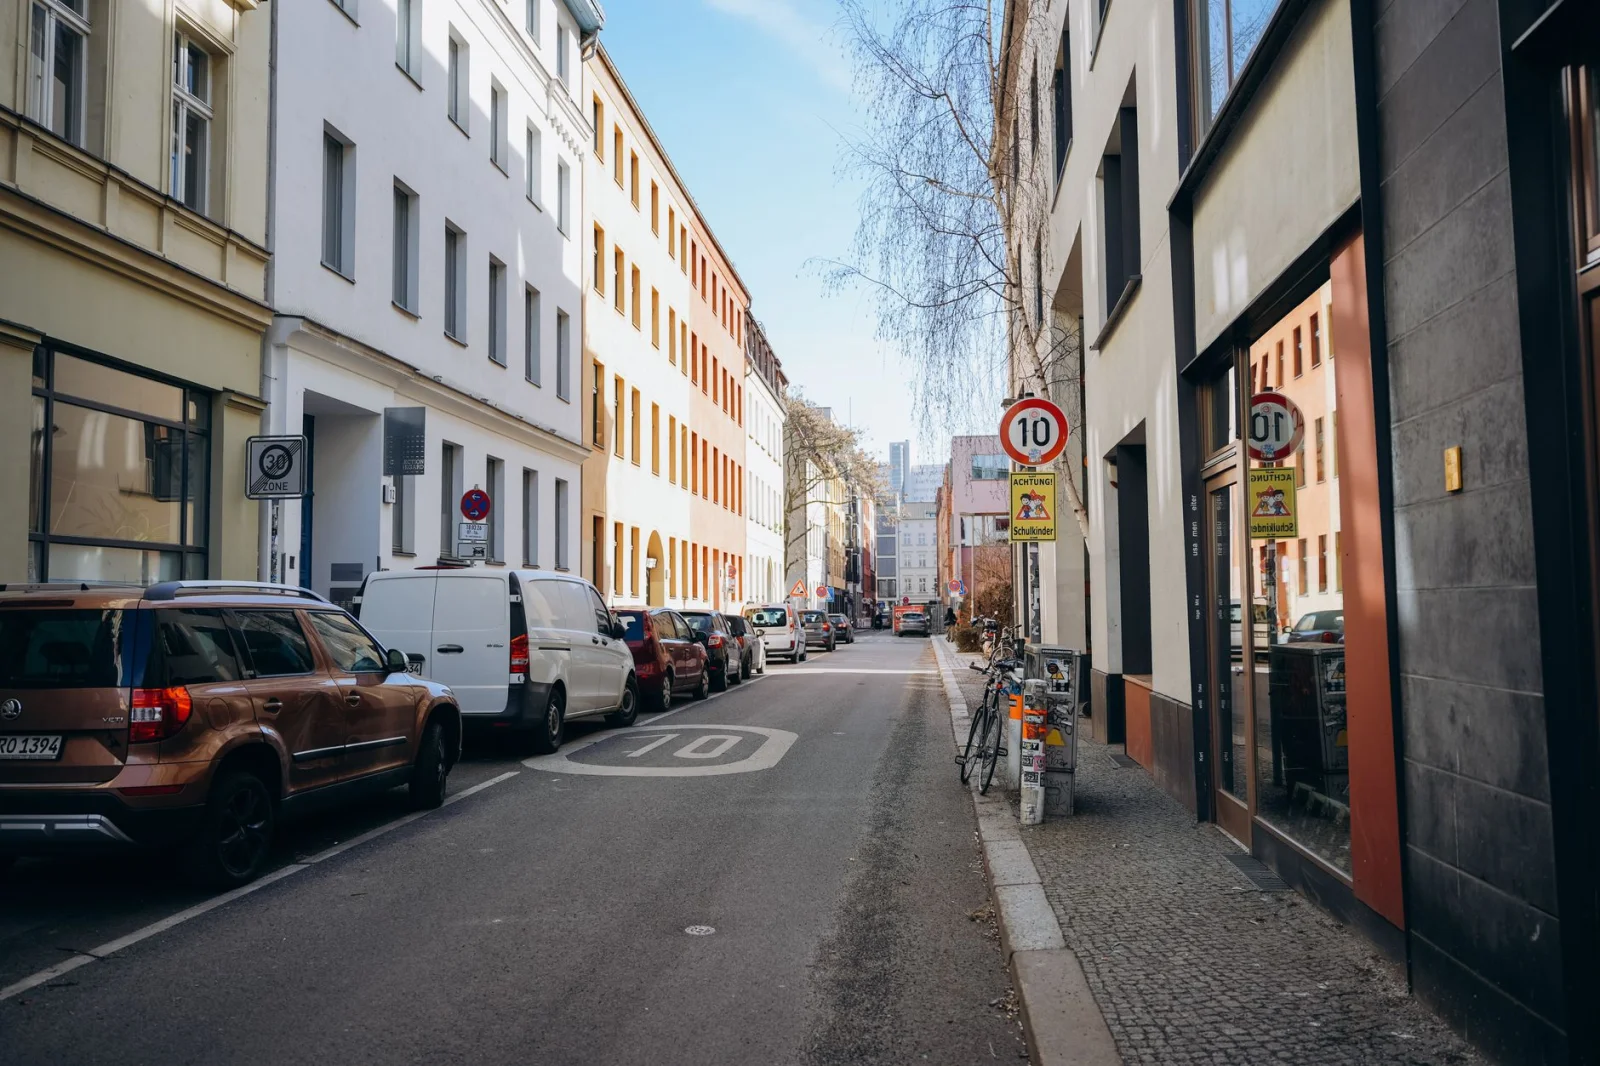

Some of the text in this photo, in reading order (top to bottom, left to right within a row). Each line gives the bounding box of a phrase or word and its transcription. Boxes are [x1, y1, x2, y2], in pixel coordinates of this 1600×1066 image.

[1017, 416, 1050, 447] 10
[266, 454, 286, 470] 30
[262, 481, 289, 491] ZONE
[1013, 478, 1053, 486] ACHTUNG!
[1013, 526, 1054, 536] Schulkinder
[19, 737, 59, 754] 1394
[621, 733, 743, 759] 10
